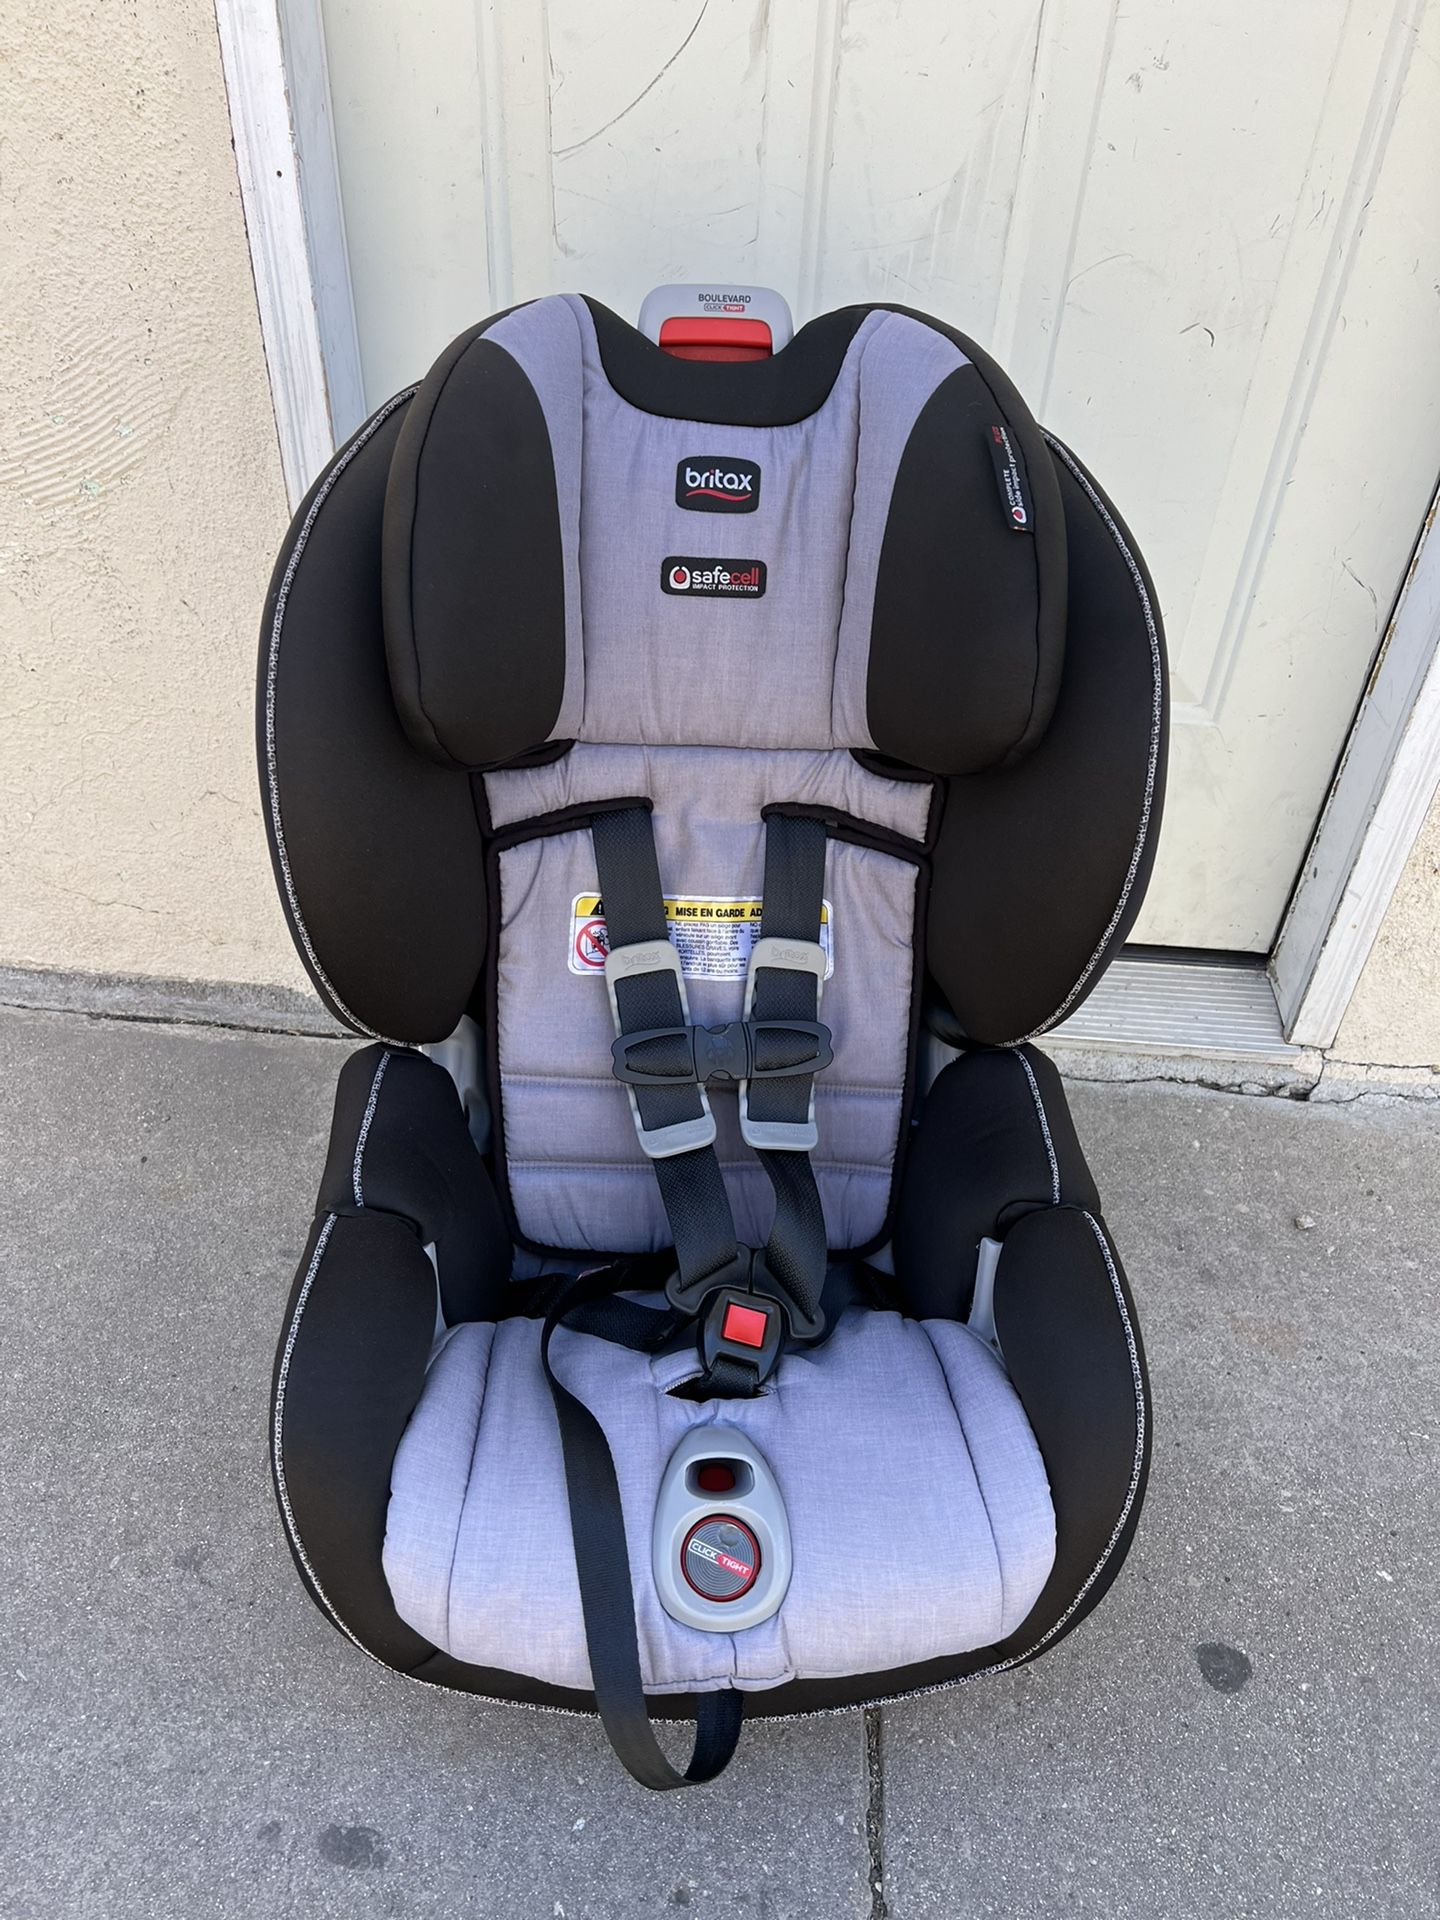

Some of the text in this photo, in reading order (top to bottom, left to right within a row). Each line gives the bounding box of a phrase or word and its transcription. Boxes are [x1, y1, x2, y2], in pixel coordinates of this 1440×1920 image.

[698, 293, 751, 303] BOULEVARD
[1000, 426, 1023, 507] side impact protection
[685, 467, 752, 491] britax
[1003, 469, 1016, 506] COMPLETE
[692, 566, 759, 586] safecell
[718, 584, 759, 592] PROTECTION
[676, 907, 698, 916] MISE
[701, 908, 713, 917] EN
[716, 908, 745, 917] GARDE
[692, 1543, 749, 1574] CLICK TIGHT
